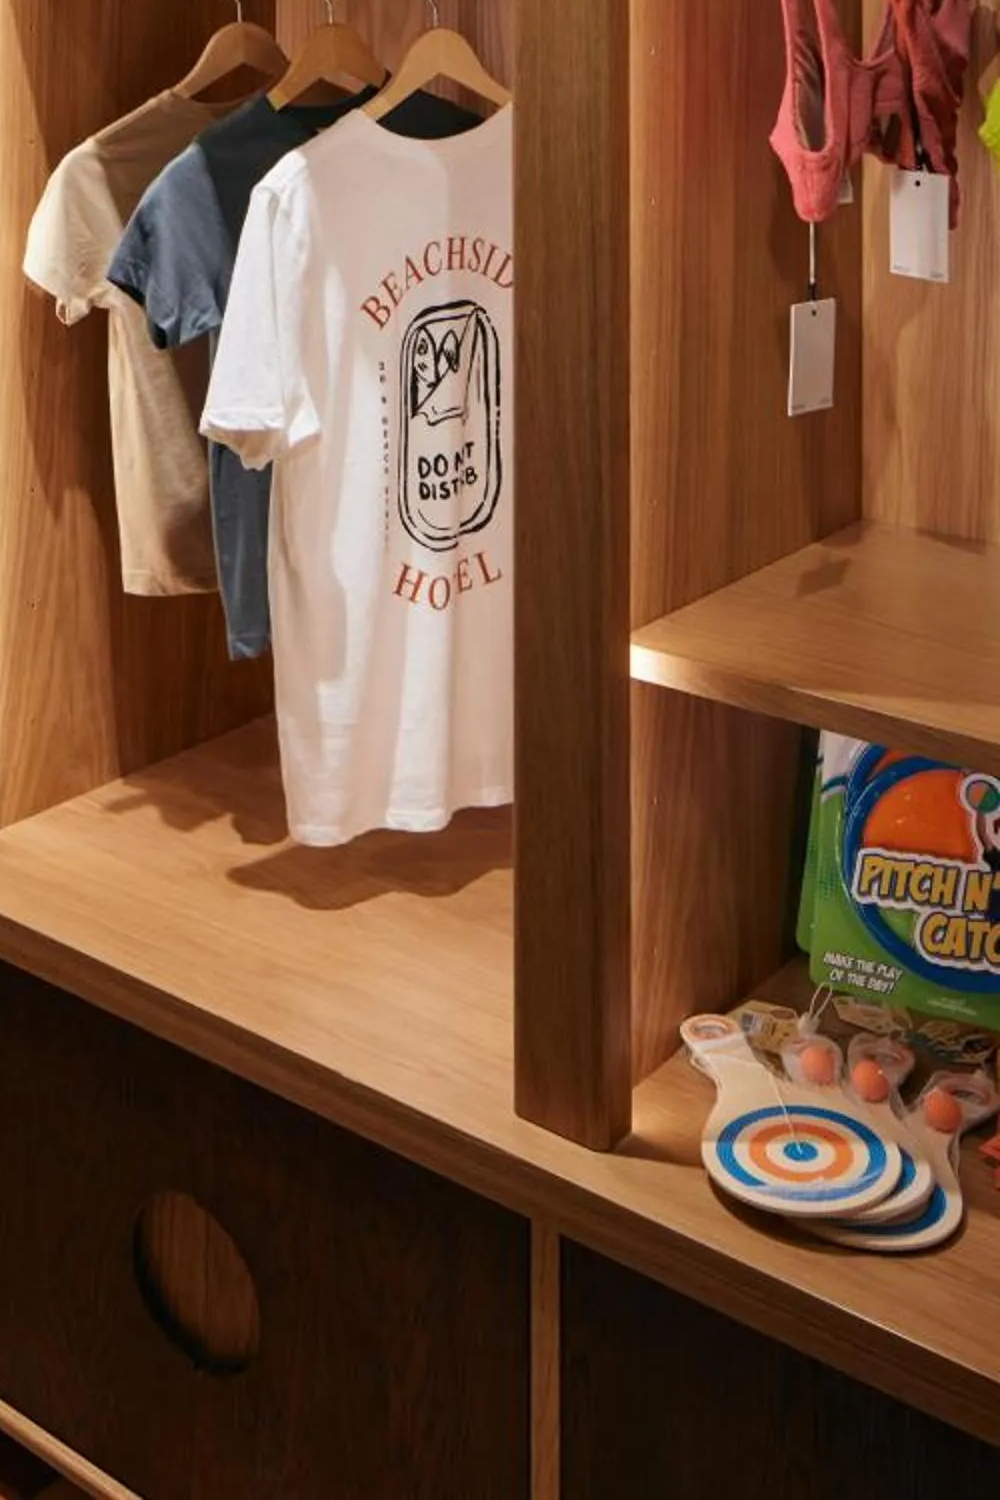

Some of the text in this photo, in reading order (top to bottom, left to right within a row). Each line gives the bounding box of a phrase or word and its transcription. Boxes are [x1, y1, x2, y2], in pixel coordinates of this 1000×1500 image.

[417, 453, 449, 480] DO
[418, 466, 478, 501] DISTB
[392, 551, 503, 612] HOEL
[858, 853, 960, 907] PITCH
[829, 968, 845, 982] OF
[846, 972, 867, 988] THE
[855, 958, 876, 974] THE
